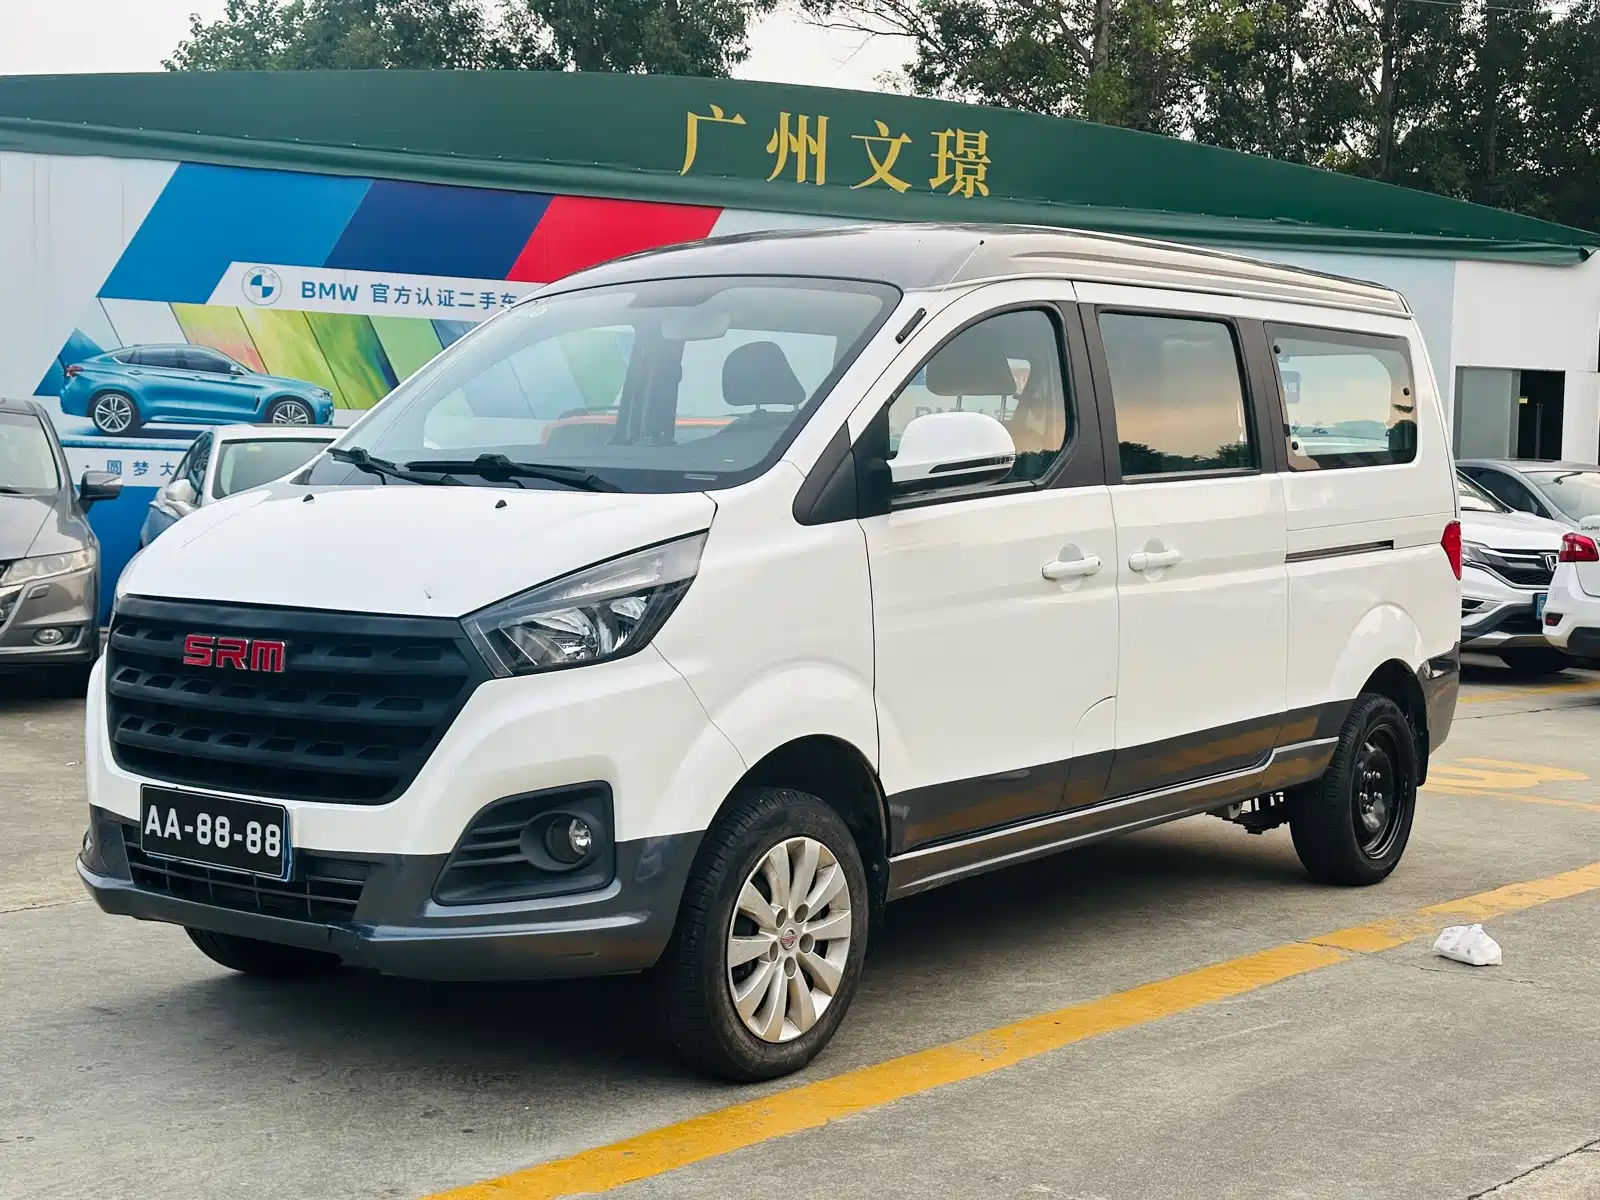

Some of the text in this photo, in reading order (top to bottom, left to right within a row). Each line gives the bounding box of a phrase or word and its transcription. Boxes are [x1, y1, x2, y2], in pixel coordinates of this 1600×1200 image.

[679, 104, 992, 199] 广州文璟
[301, 281, 358, 301] BMW
[183, 633, 286, 673] SRM
[144, 804, 281, 857] AA-88-88
